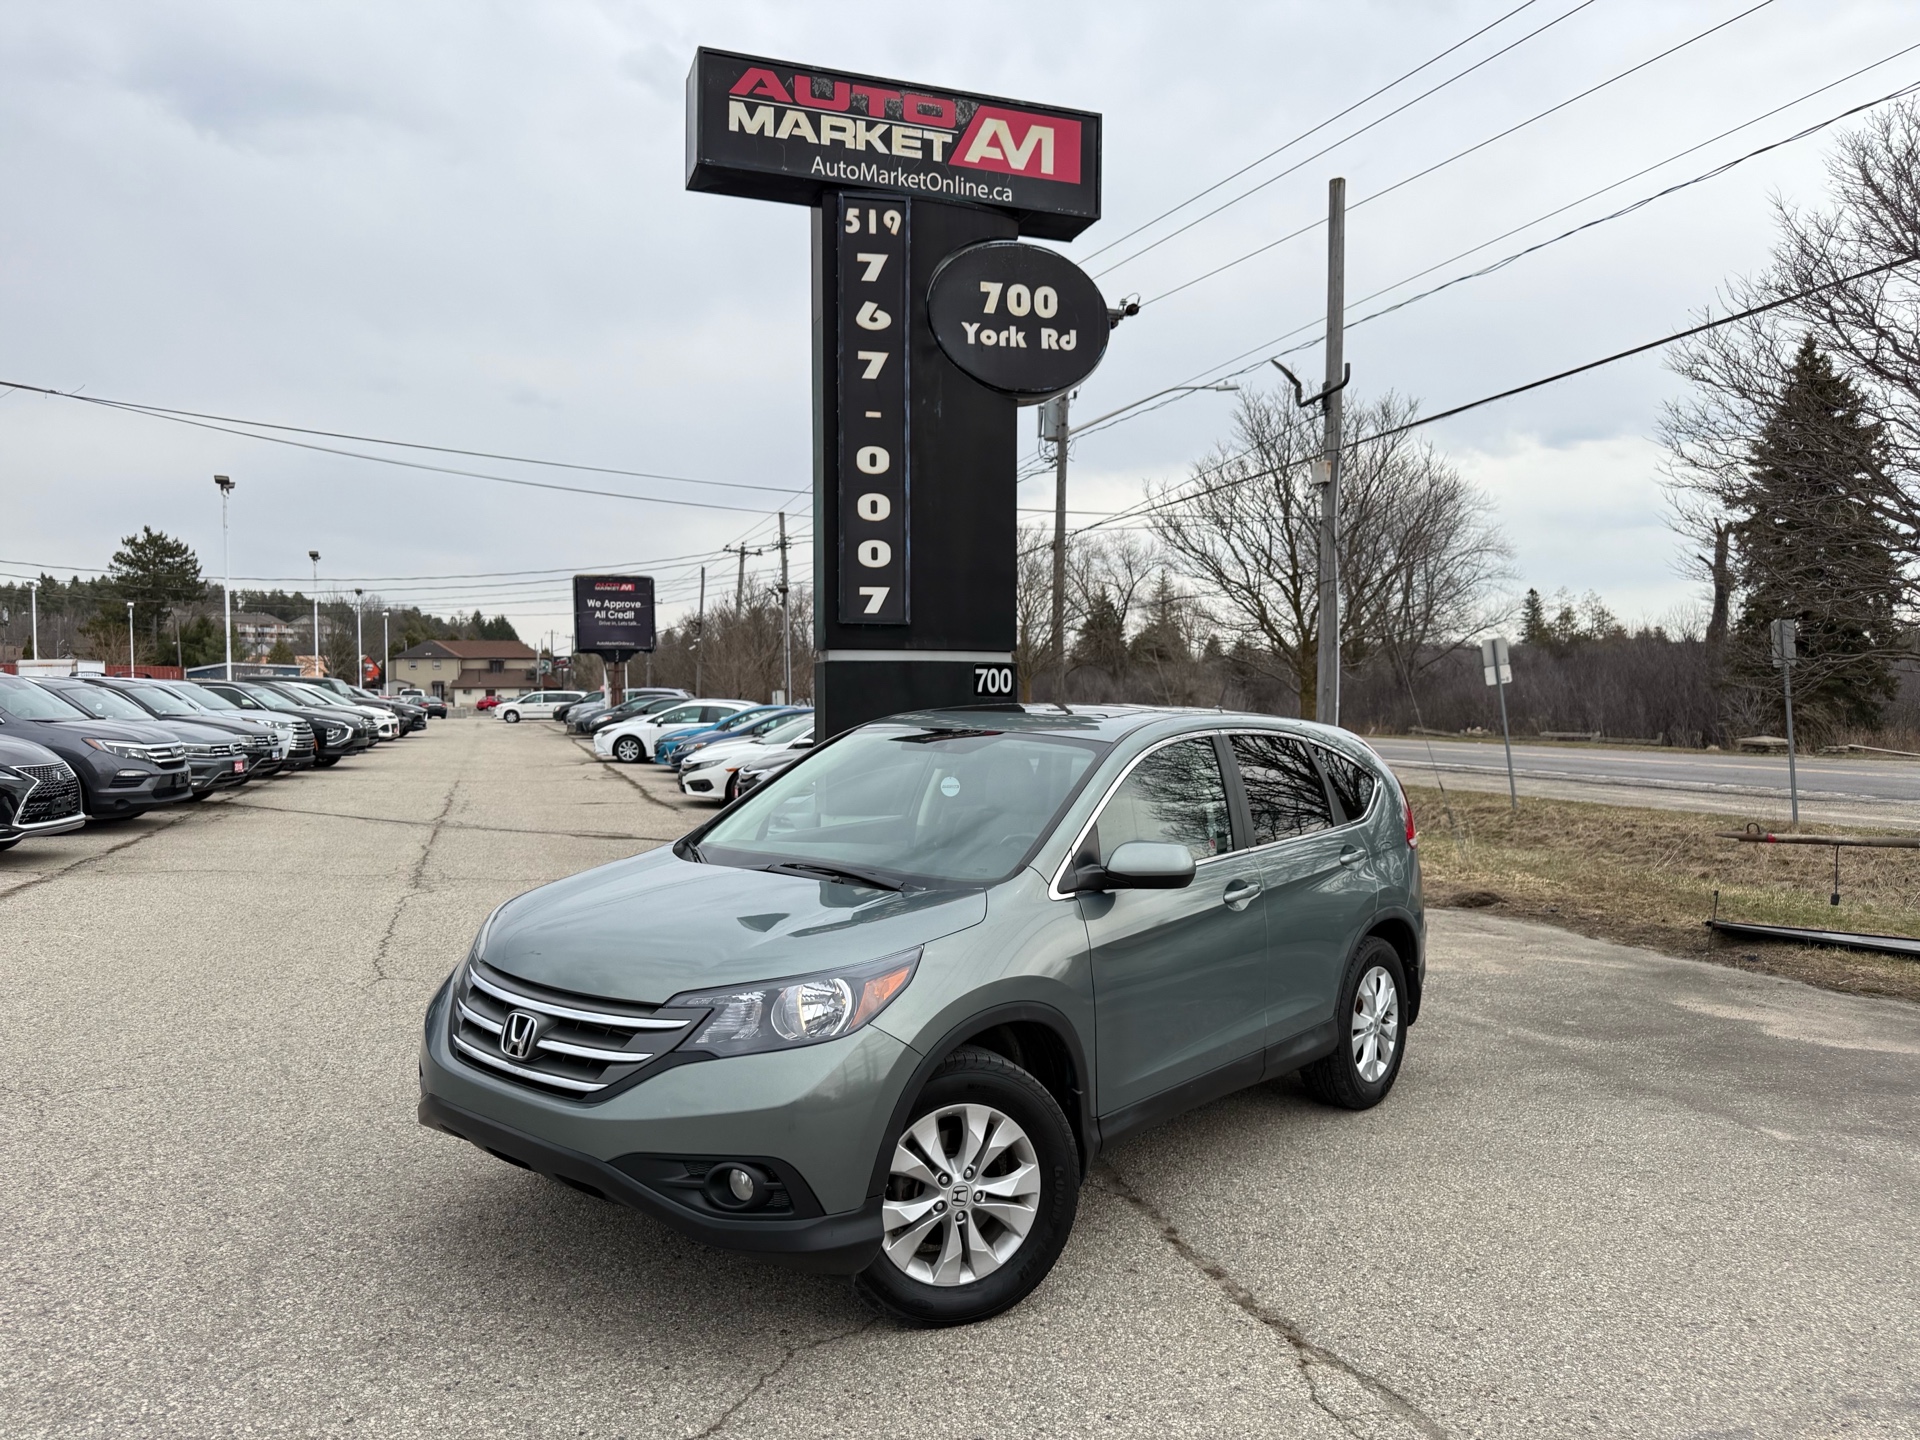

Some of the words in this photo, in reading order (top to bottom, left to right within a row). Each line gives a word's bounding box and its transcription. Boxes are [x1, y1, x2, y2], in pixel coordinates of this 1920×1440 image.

[729, 67, 956, 129] AUTO
[728, 100, 953, 163] MARKET
[811, 156, 1013, 202] AutoMarketOnline.ca
[845, 208, 902, 236] 519
[980, 281, 1059, 319] 700
[961, 321, 1028, 348] York
[1040, 327, 1077, 351] Rd
[587, 599, 602, 608] We
[603, 599, 642, 610] Approve
[594, 610, 606, 619] All
[607, 610, 635, 620] Credit
[975, 668, 1013, 694] 700
